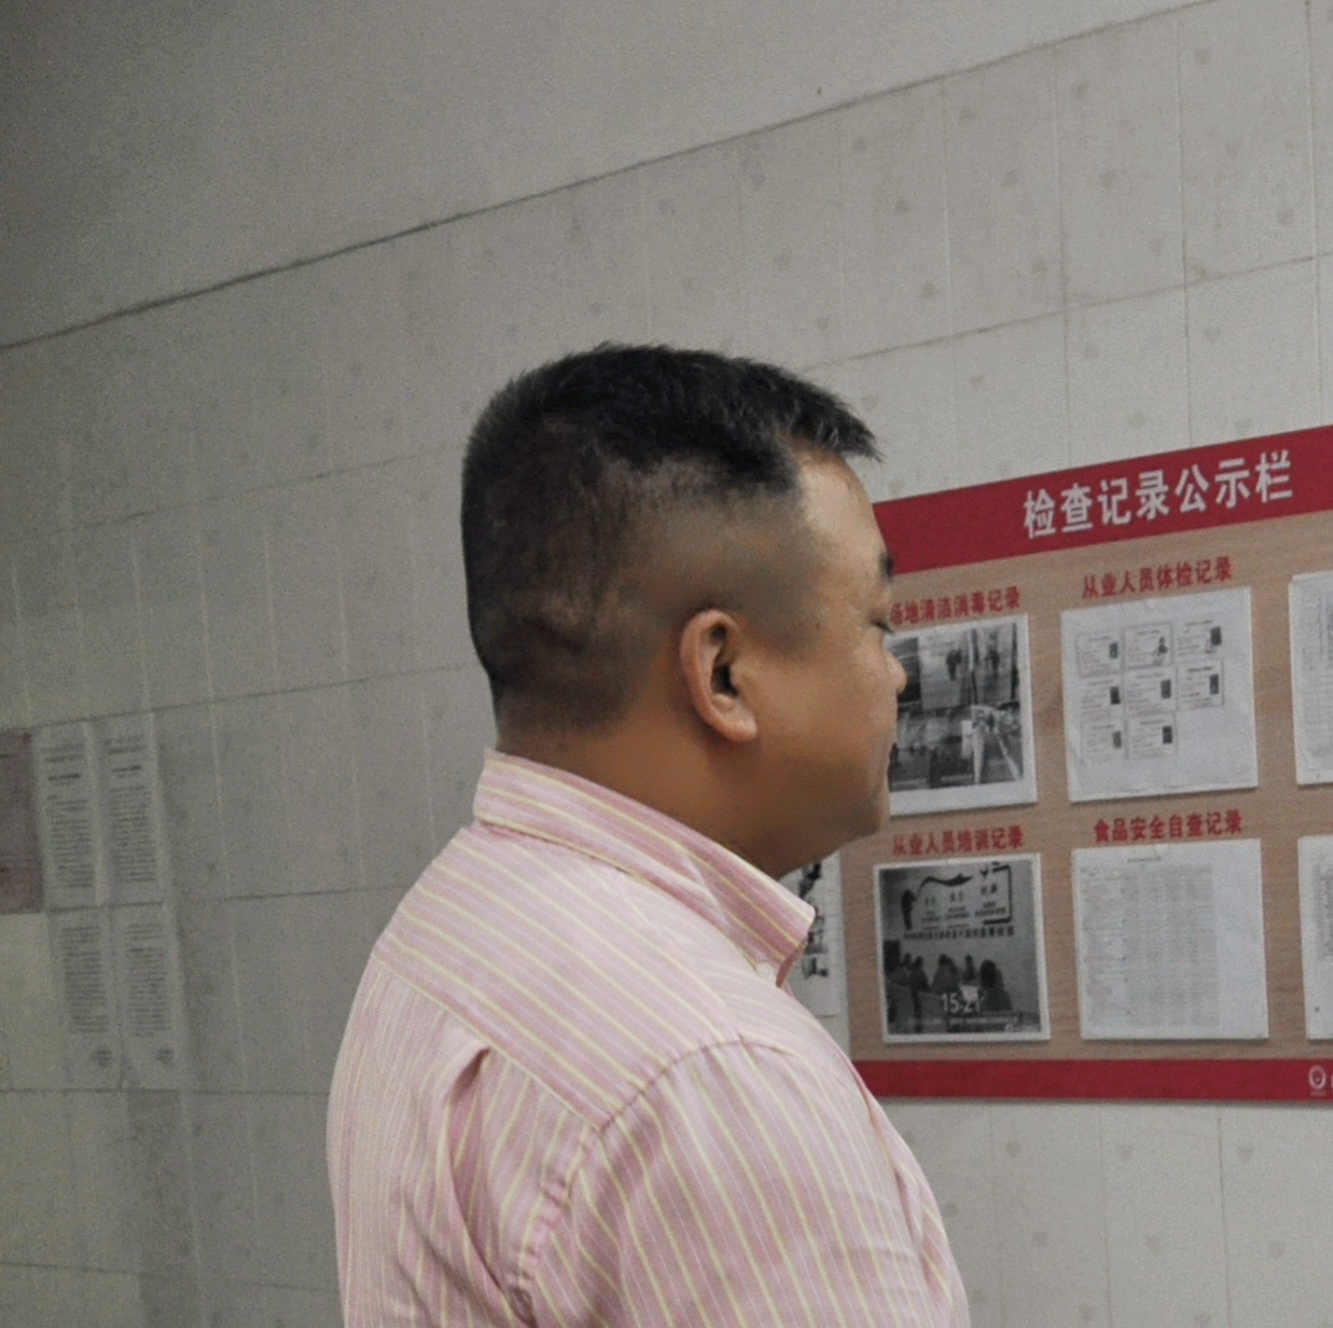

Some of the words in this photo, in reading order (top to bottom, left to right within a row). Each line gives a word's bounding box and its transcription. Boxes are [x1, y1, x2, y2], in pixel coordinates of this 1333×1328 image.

[1023, 449, 1293, 539] 检查记录公示栏
[1082, 556, 1233, 599] 从业人员体检记录
[1094, 809, 1242, 843] 食品安全自查记录
